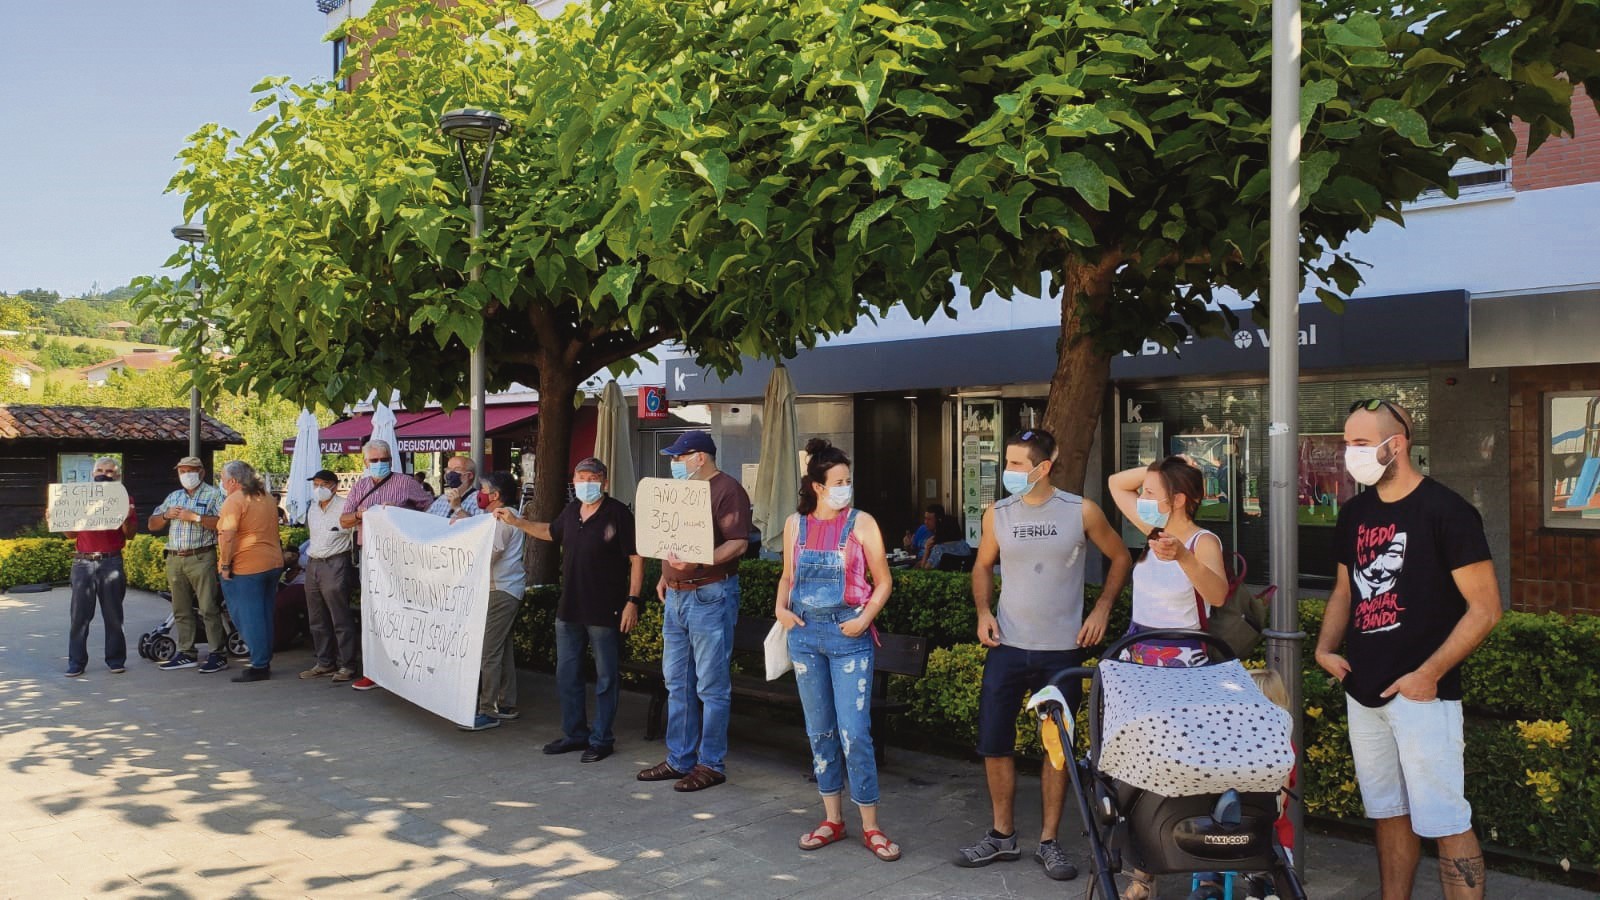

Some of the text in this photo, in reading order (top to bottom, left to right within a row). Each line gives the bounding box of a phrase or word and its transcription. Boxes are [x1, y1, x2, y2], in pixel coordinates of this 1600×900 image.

[1257, 324, 1317, 348] Val
[320, 443, 343, 453] PLAZA
[398, 440, 455, 451] DEGUSTACION
[653, 483, 678, 505] AÑO
[650, 508, 680, 533] 350
[1012, 524, 1058, 538] TERNUA
